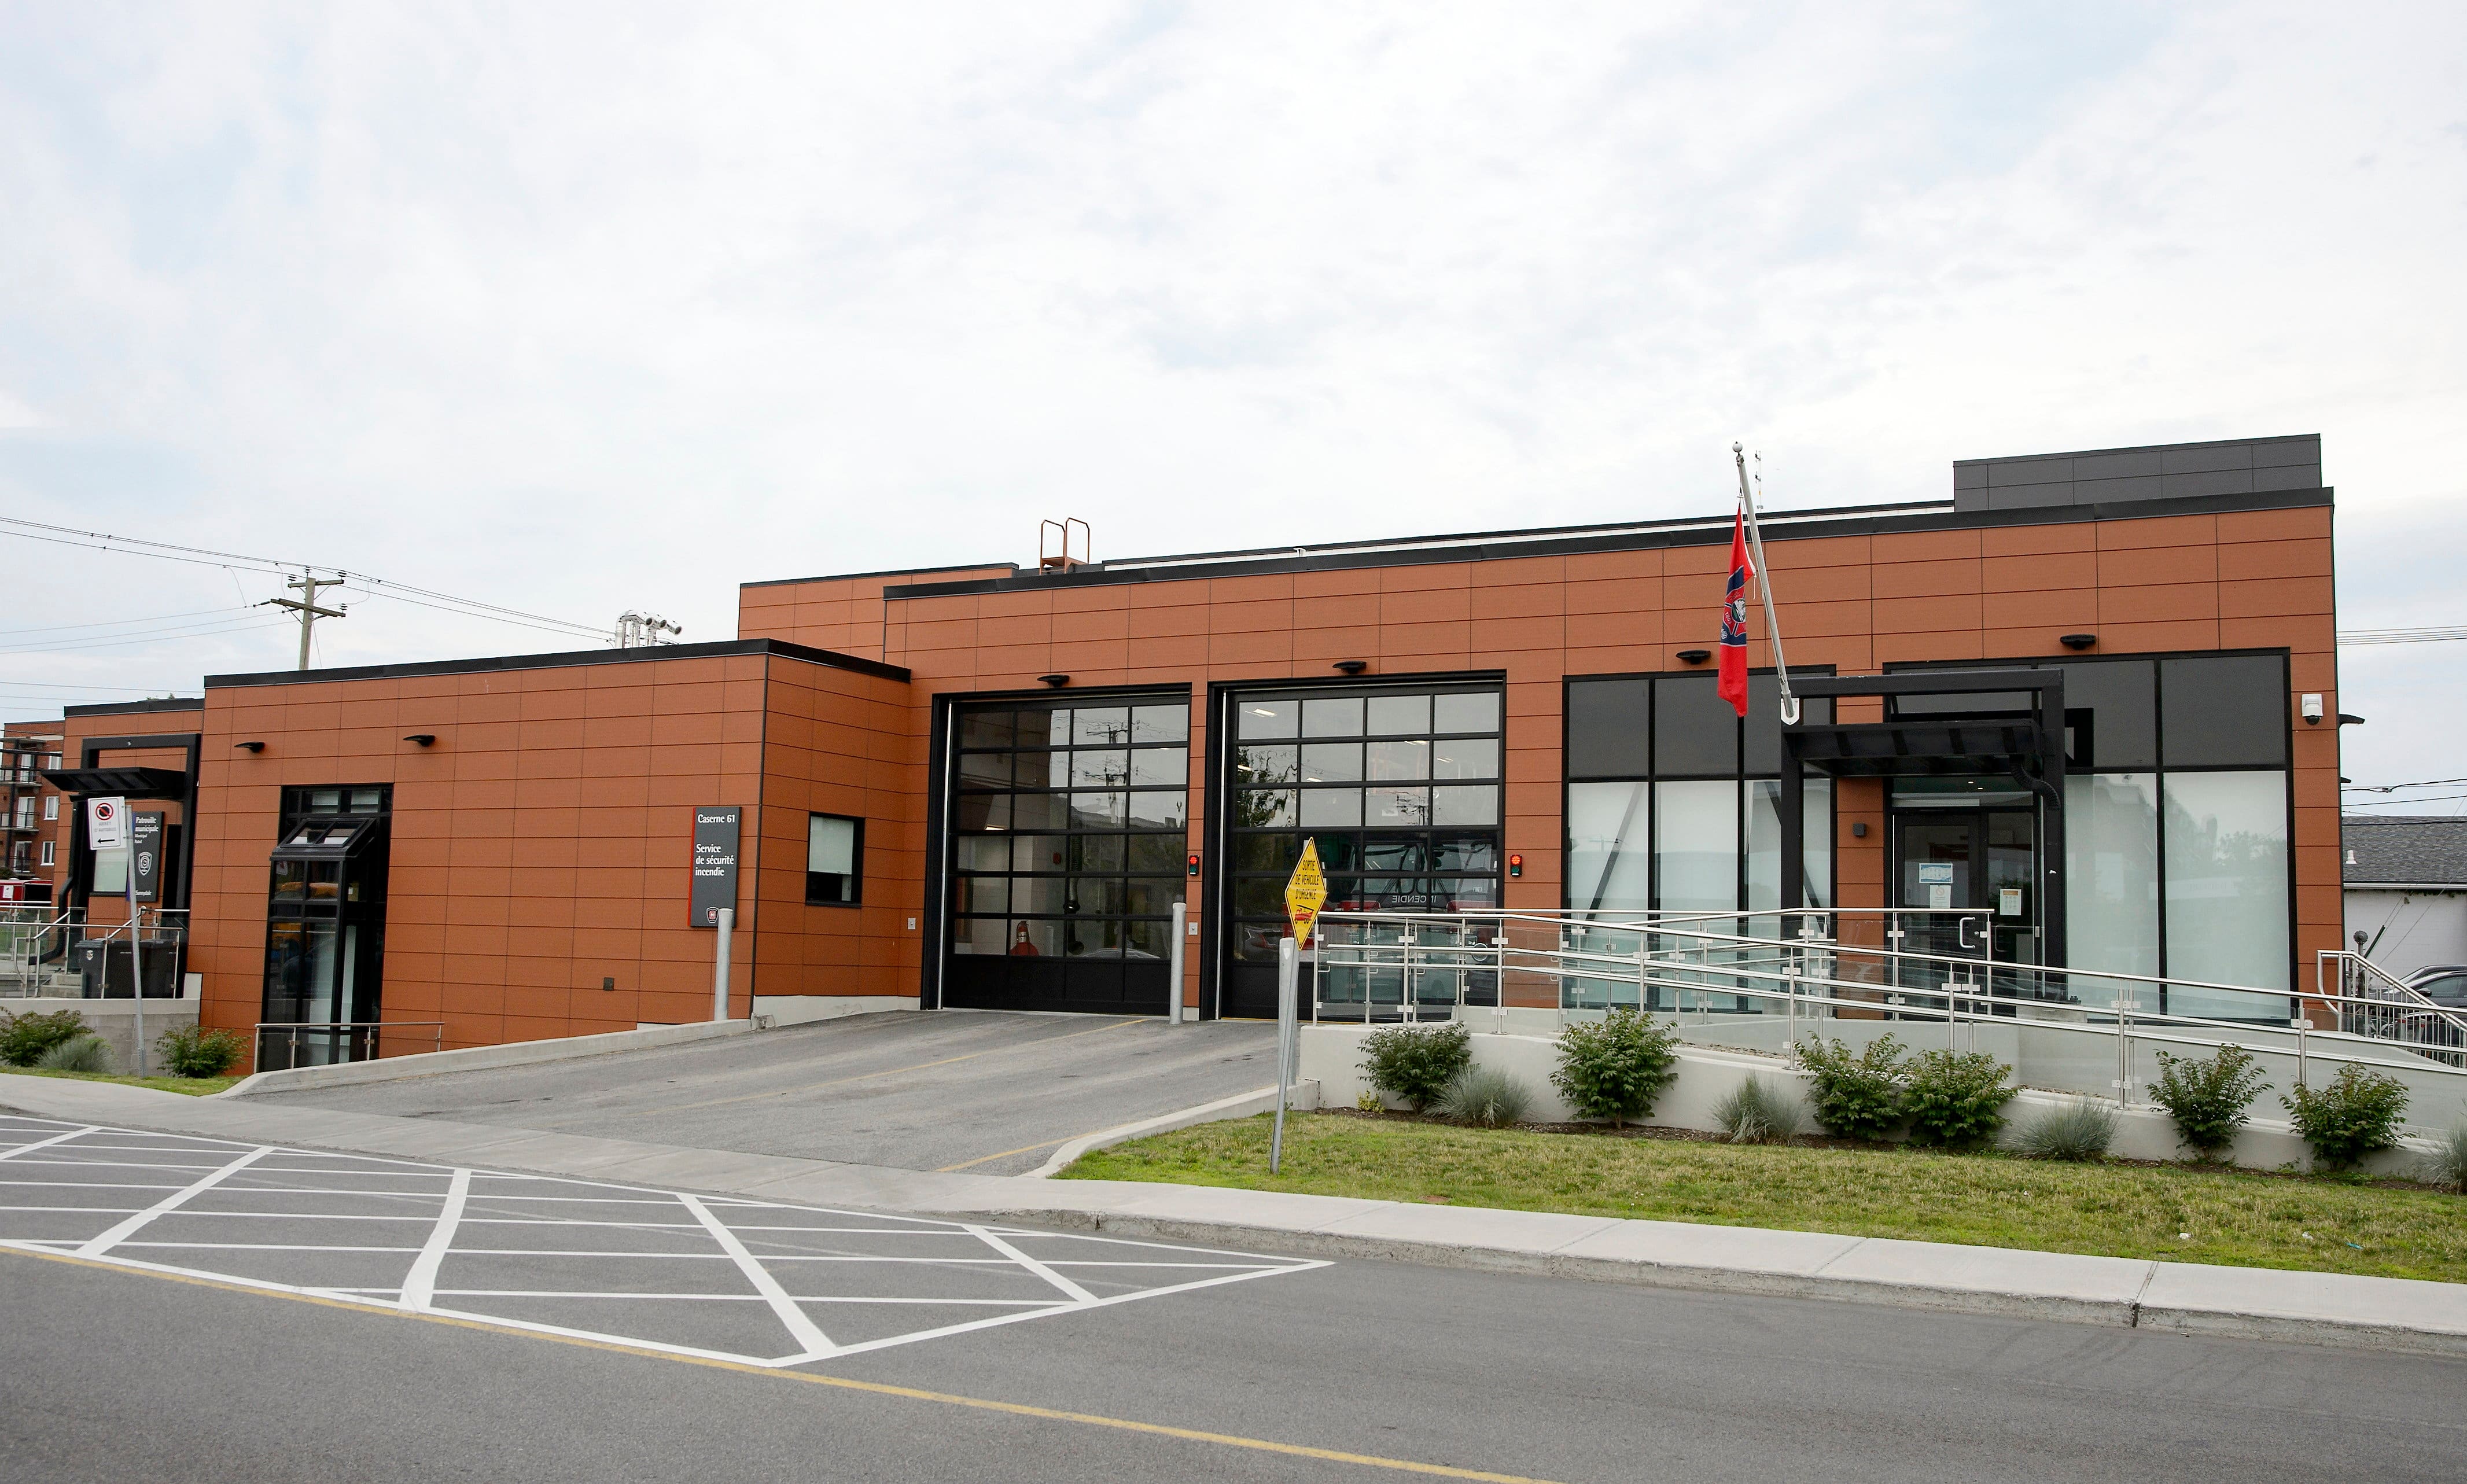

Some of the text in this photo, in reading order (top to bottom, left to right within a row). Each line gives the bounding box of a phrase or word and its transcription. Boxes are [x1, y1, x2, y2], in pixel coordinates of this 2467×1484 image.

[697, 814, 735, 823] Caserne 61
[695, 844, 721, 853] Service
[695, 855, 734, 864] de sécurité
[1302, 860, 1316, 871] SORTIE
[695, 867, 725, 876] incendie
[1295, 871, 1320, 885] DE VÉHICULE
